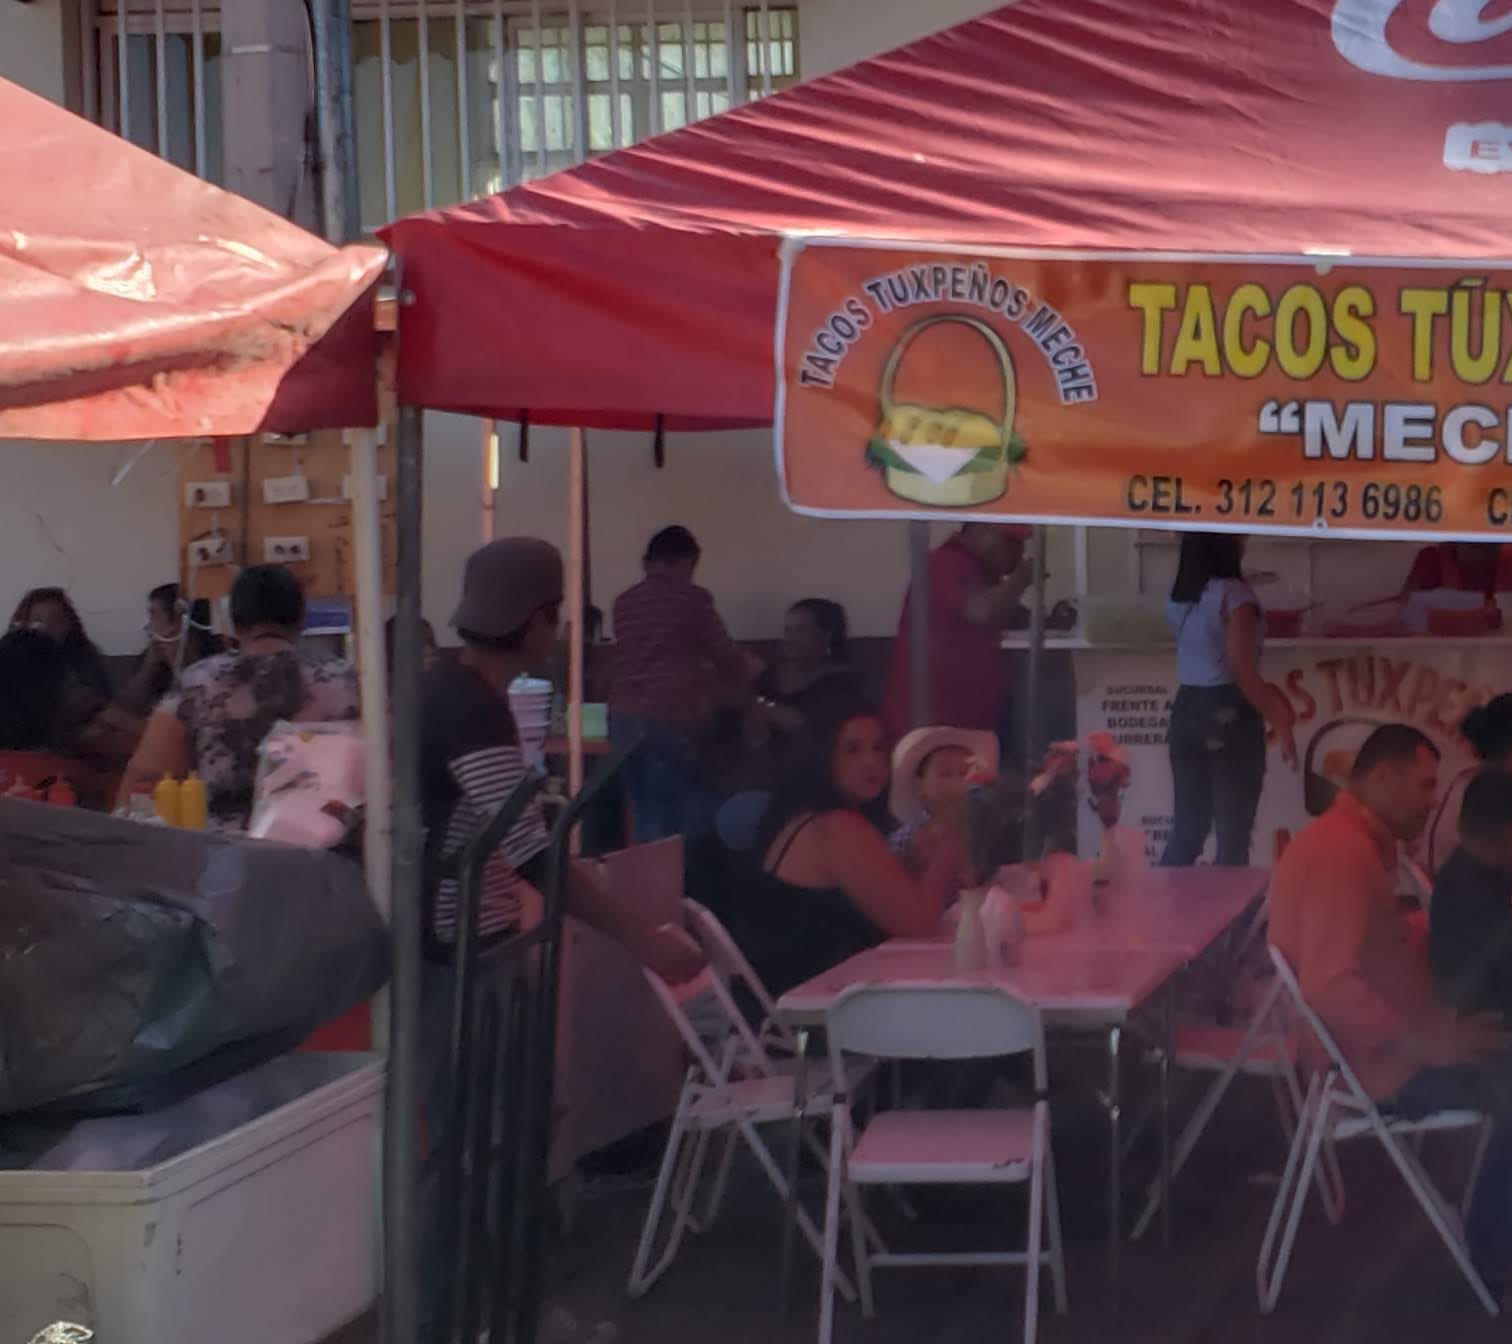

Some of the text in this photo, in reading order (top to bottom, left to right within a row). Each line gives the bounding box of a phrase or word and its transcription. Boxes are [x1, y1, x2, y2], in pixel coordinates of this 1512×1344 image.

[800, 263, 1097, 404] TACOS TUXPEÑOS MECHE
[1128, 282, 1377, 381] TACOS
[1126, 474, 1444, 523] CEL. 312 113 6986
